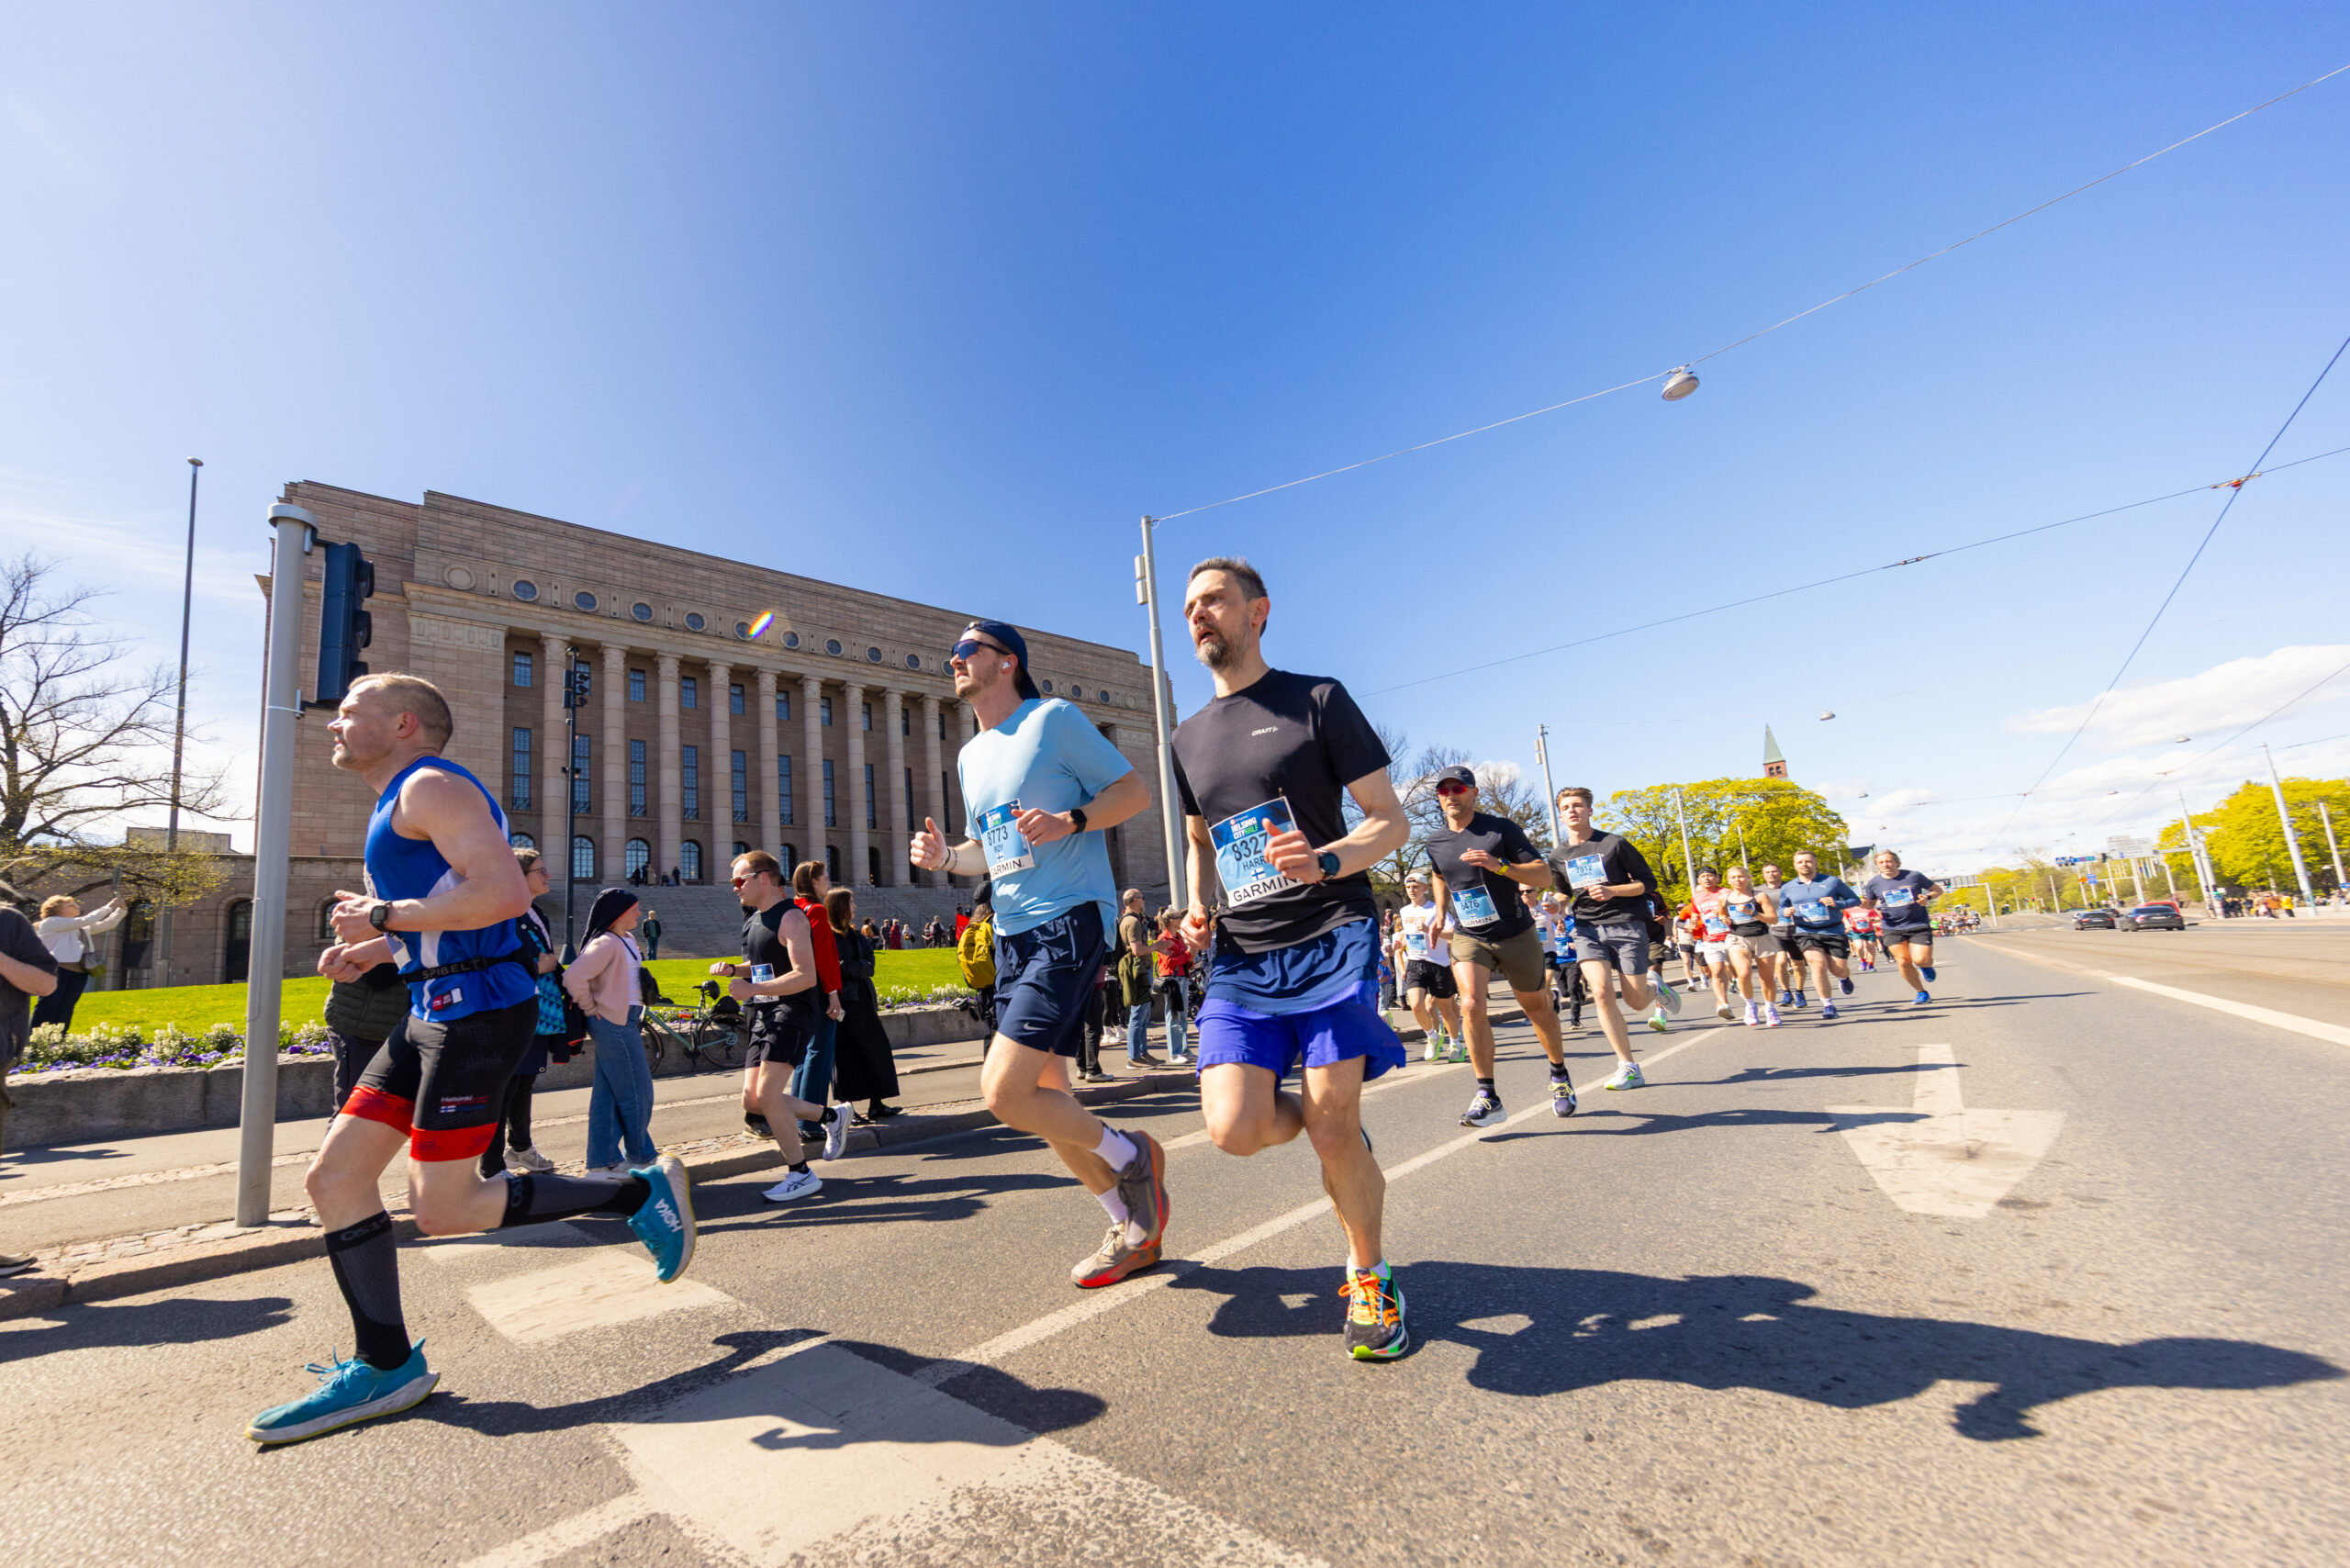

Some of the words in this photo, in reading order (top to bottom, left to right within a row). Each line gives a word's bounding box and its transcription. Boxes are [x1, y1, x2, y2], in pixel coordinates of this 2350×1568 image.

[1231, 817, 1258, 833] HELSINKI
[987, 825, 1009, 846] 8773
[993, 844, 1003, 853] ROY
[1231, 833, 1269, 861] 8327
[1242, 856, 1268, 871] HARR
[1575, 865, 1593, 873] 7912
[1233, 876, 1298, 902] GARMIN
[1460, 899, 1480, 910] 8476
[422, 960, 478, 980] SPIBELT
[654, 1198, 684, 1232] HOKA
